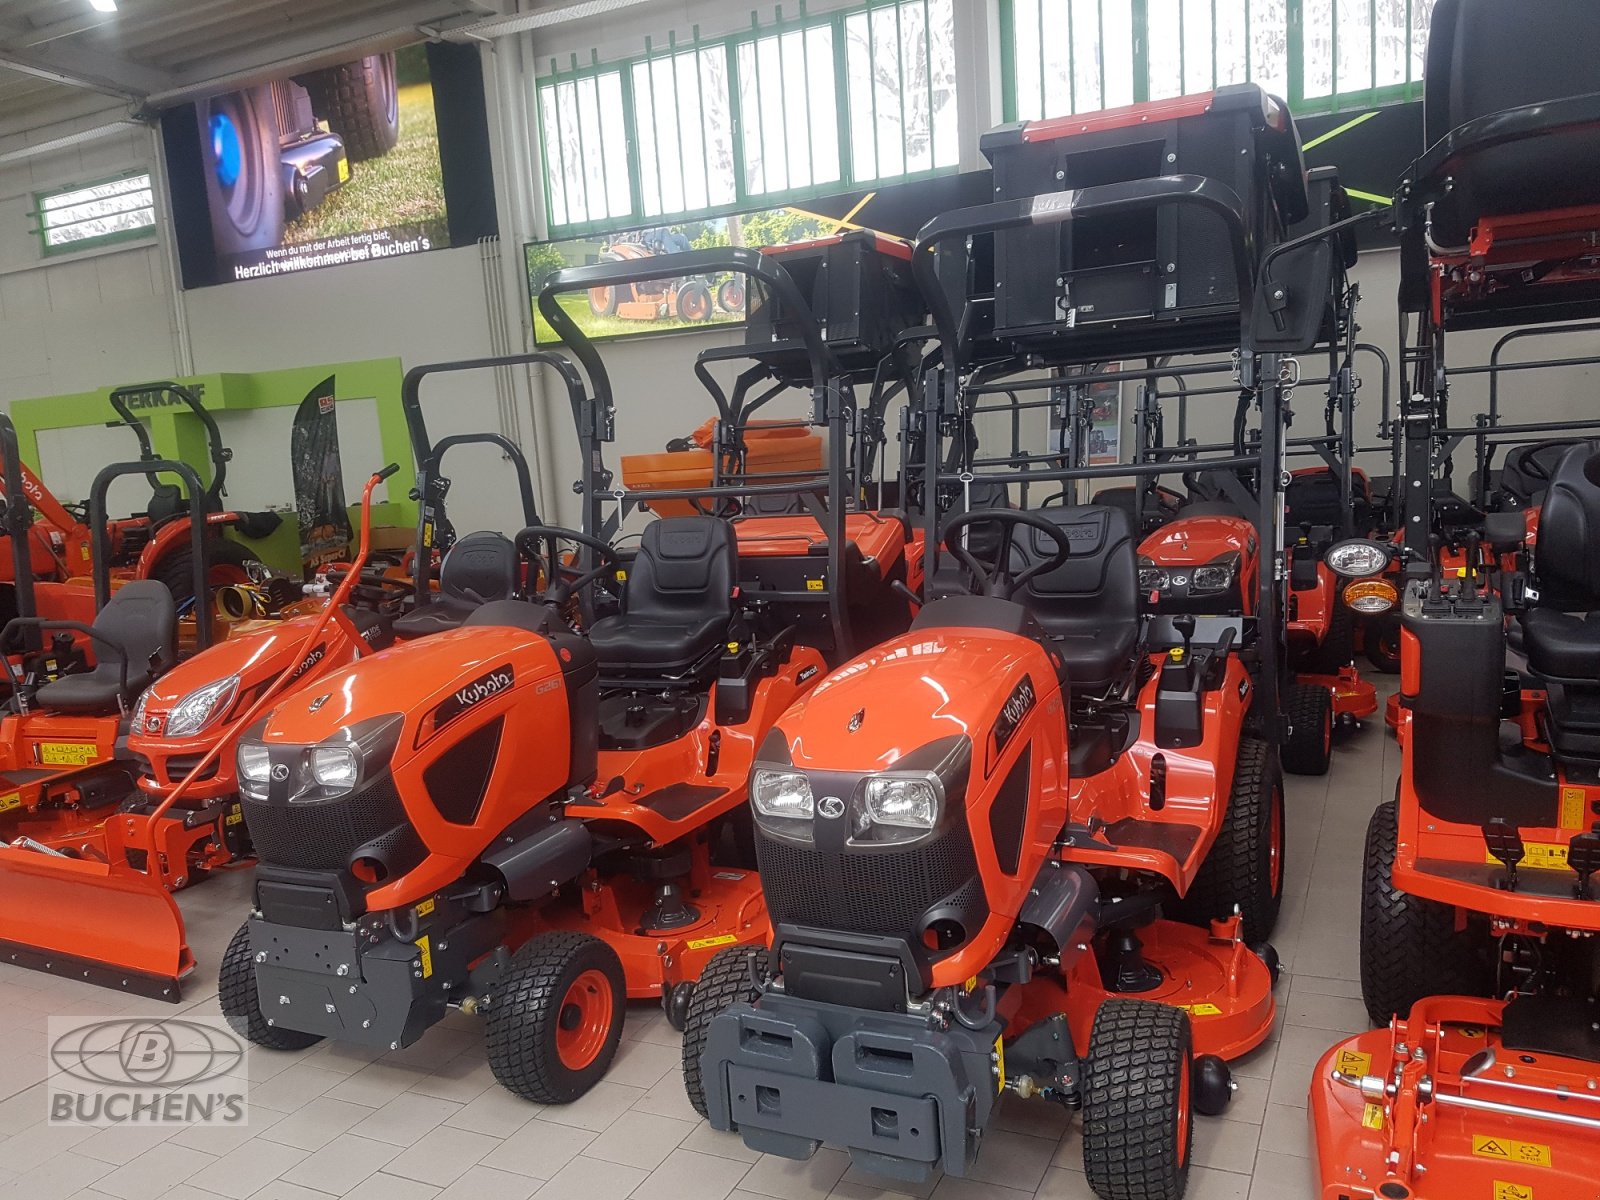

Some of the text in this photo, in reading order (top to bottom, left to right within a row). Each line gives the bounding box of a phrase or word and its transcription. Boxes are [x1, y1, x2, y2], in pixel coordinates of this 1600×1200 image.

[266, 230, 390, 258] Wenn du mit der Arbeit fertig bist,
[234, 260, 280, 279] Herzlich
[456, 673, 510, 705] Kubota
[1003, 685, 1033, 724] Kubota
